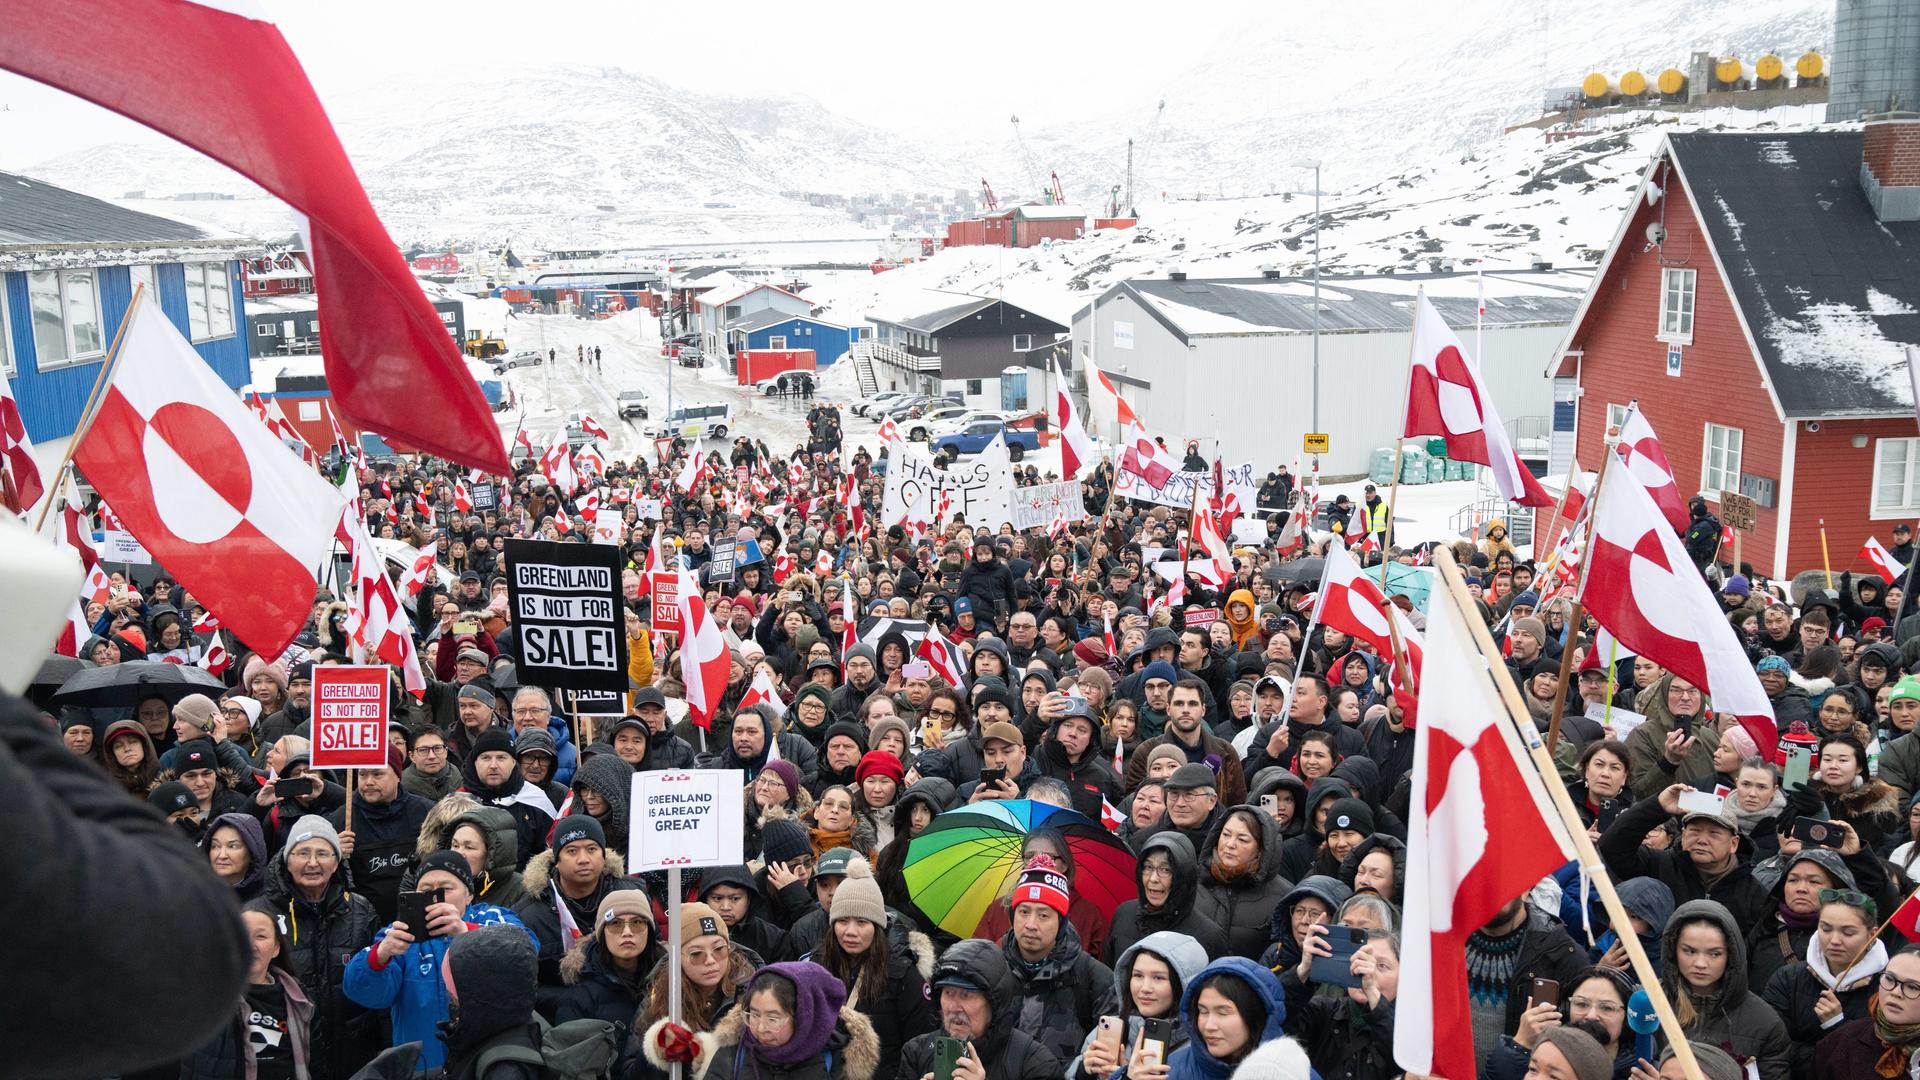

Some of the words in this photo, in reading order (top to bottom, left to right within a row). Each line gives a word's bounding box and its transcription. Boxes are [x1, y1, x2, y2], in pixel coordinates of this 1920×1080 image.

[1136, 477, 1196, 506] FUTUR
[1725, 493, 1737, 504] WE
[1724, 503, 1737, 513] NOT
[519, 566, 608, 589] GREENLAND
[657, 583, 678, 591] GREENL
[521, 597, 536, 615] IS
[544, 598, 572, 618] NOT
[581, 599, 611, 618] FOR
[658, 605, 678, 621] SAL
[525, 627, 615, 668] SALE!
[323, 685, 379, 698] GREENLAND
[323, 704, 332, 717] IS
[336, 704, 355, 717] NOT
[360, 704, 378, 717] FOR
[322, 724, 378, 749] SALE!
[648, 793, 712, 805] GREENLAND
[648, 808, 656, 817] IS
[658, 806, 711, 817] ALREADY
[655, 819, 700, 831] GREAT
